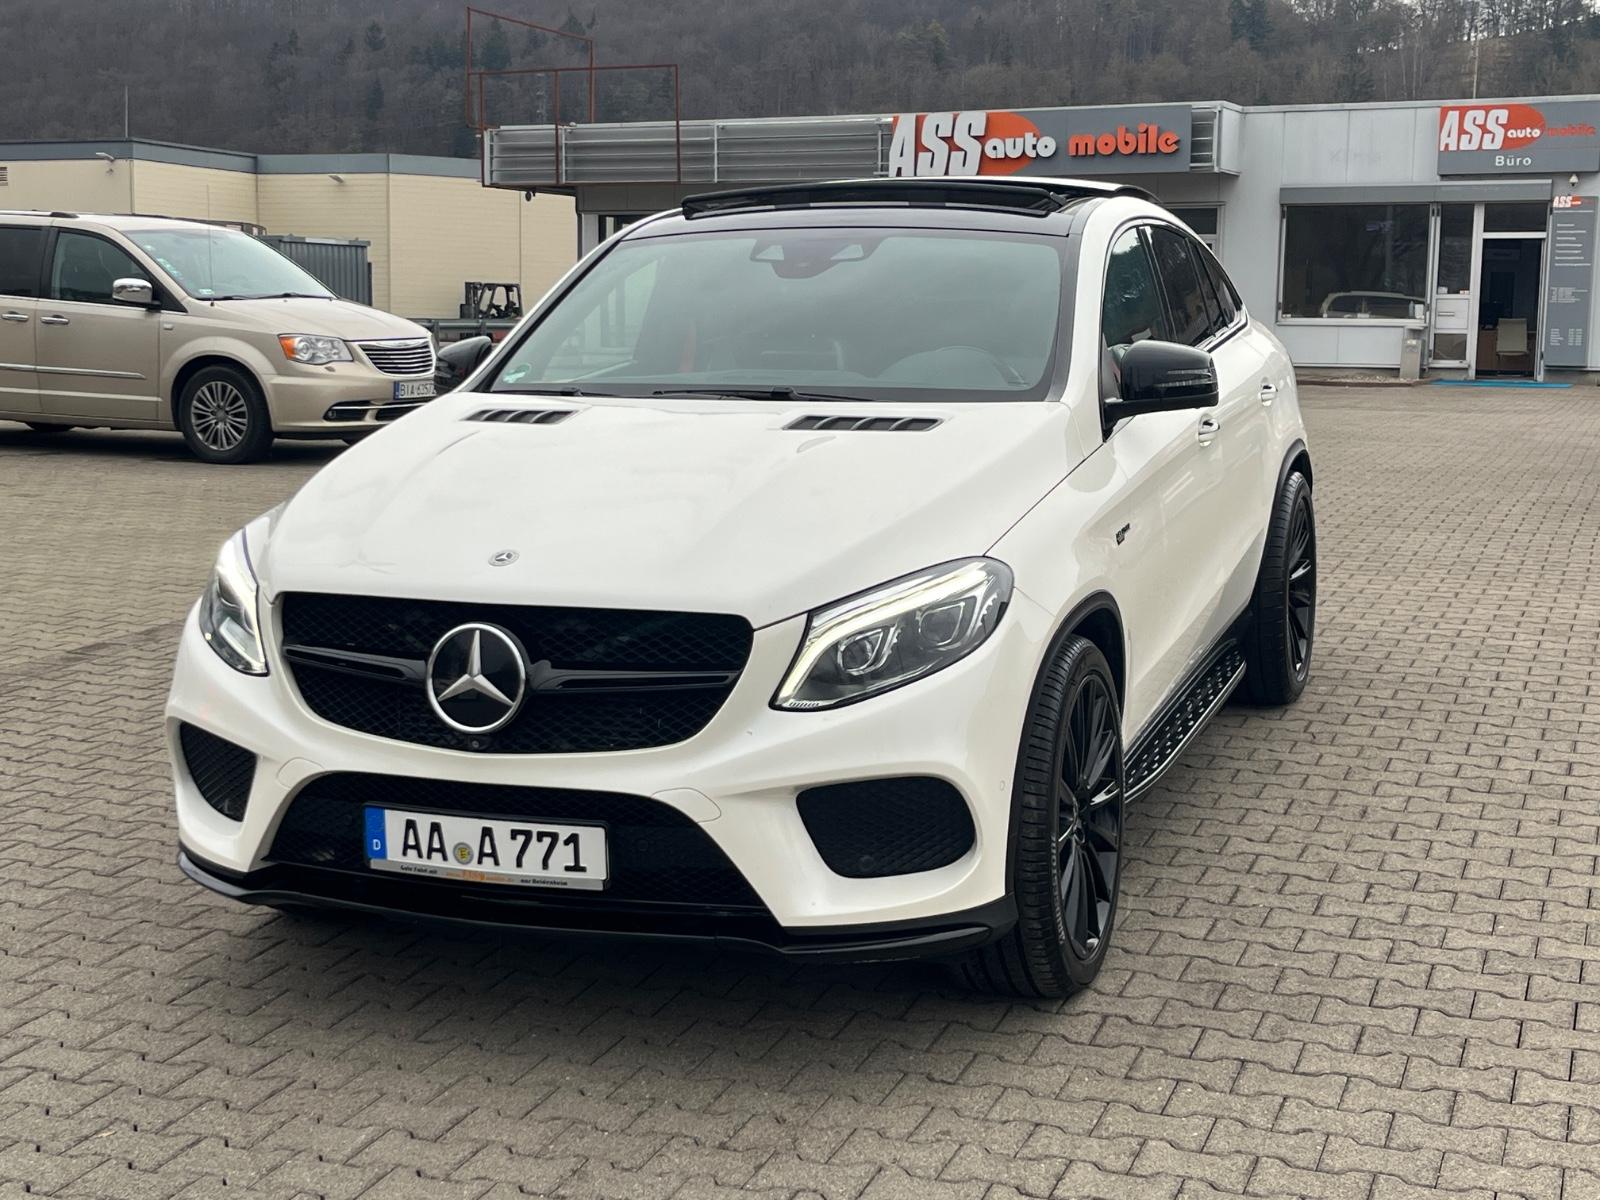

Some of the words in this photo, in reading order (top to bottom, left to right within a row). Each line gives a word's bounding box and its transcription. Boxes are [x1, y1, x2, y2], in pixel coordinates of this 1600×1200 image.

[1440, 109, 1509, 151] ASS
[1507, 127, 1541, 138] auto
[1547, 122, 1596, 137] mobile
[889, 112, 988, 177] ASS
[985, 132, 1057, 159] auto
[1068, 122, 1181, 157] mobile
[1495, 155, 1532, 167] Büro
[1553, 196, 1573, 208] ASS
[372, 839, 382, 850] D
[402, 818, 448, 862] AA
[477, 826, 500, 866] A
[510, 828, 587, 873] 771
